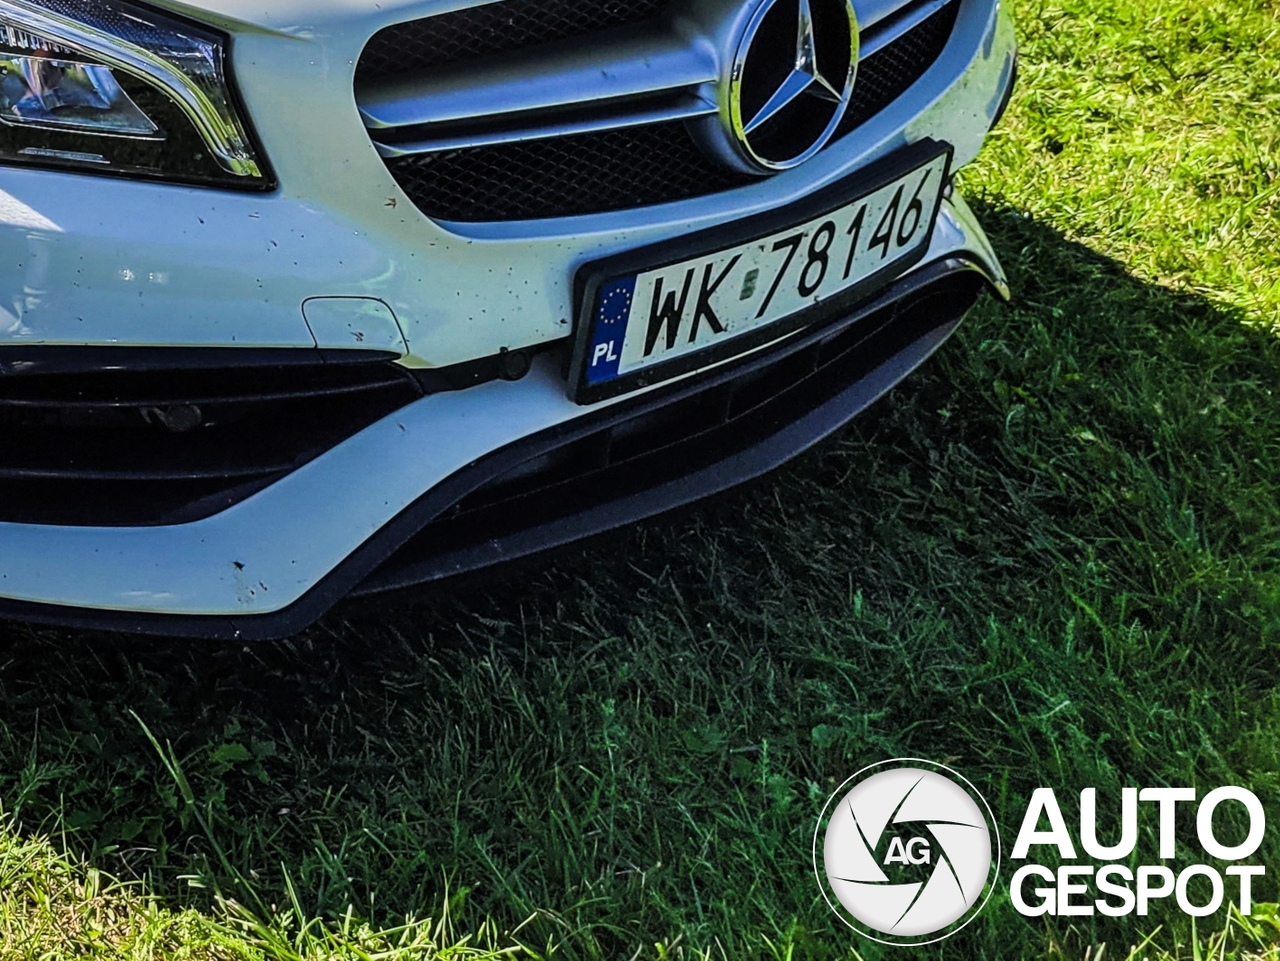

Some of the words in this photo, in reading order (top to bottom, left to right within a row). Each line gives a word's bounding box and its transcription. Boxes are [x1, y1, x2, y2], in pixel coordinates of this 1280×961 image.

[643, 253, 743, 358] WK
[756, 167, 933, 320] 78146
[591, 339, 618, 367] PL
